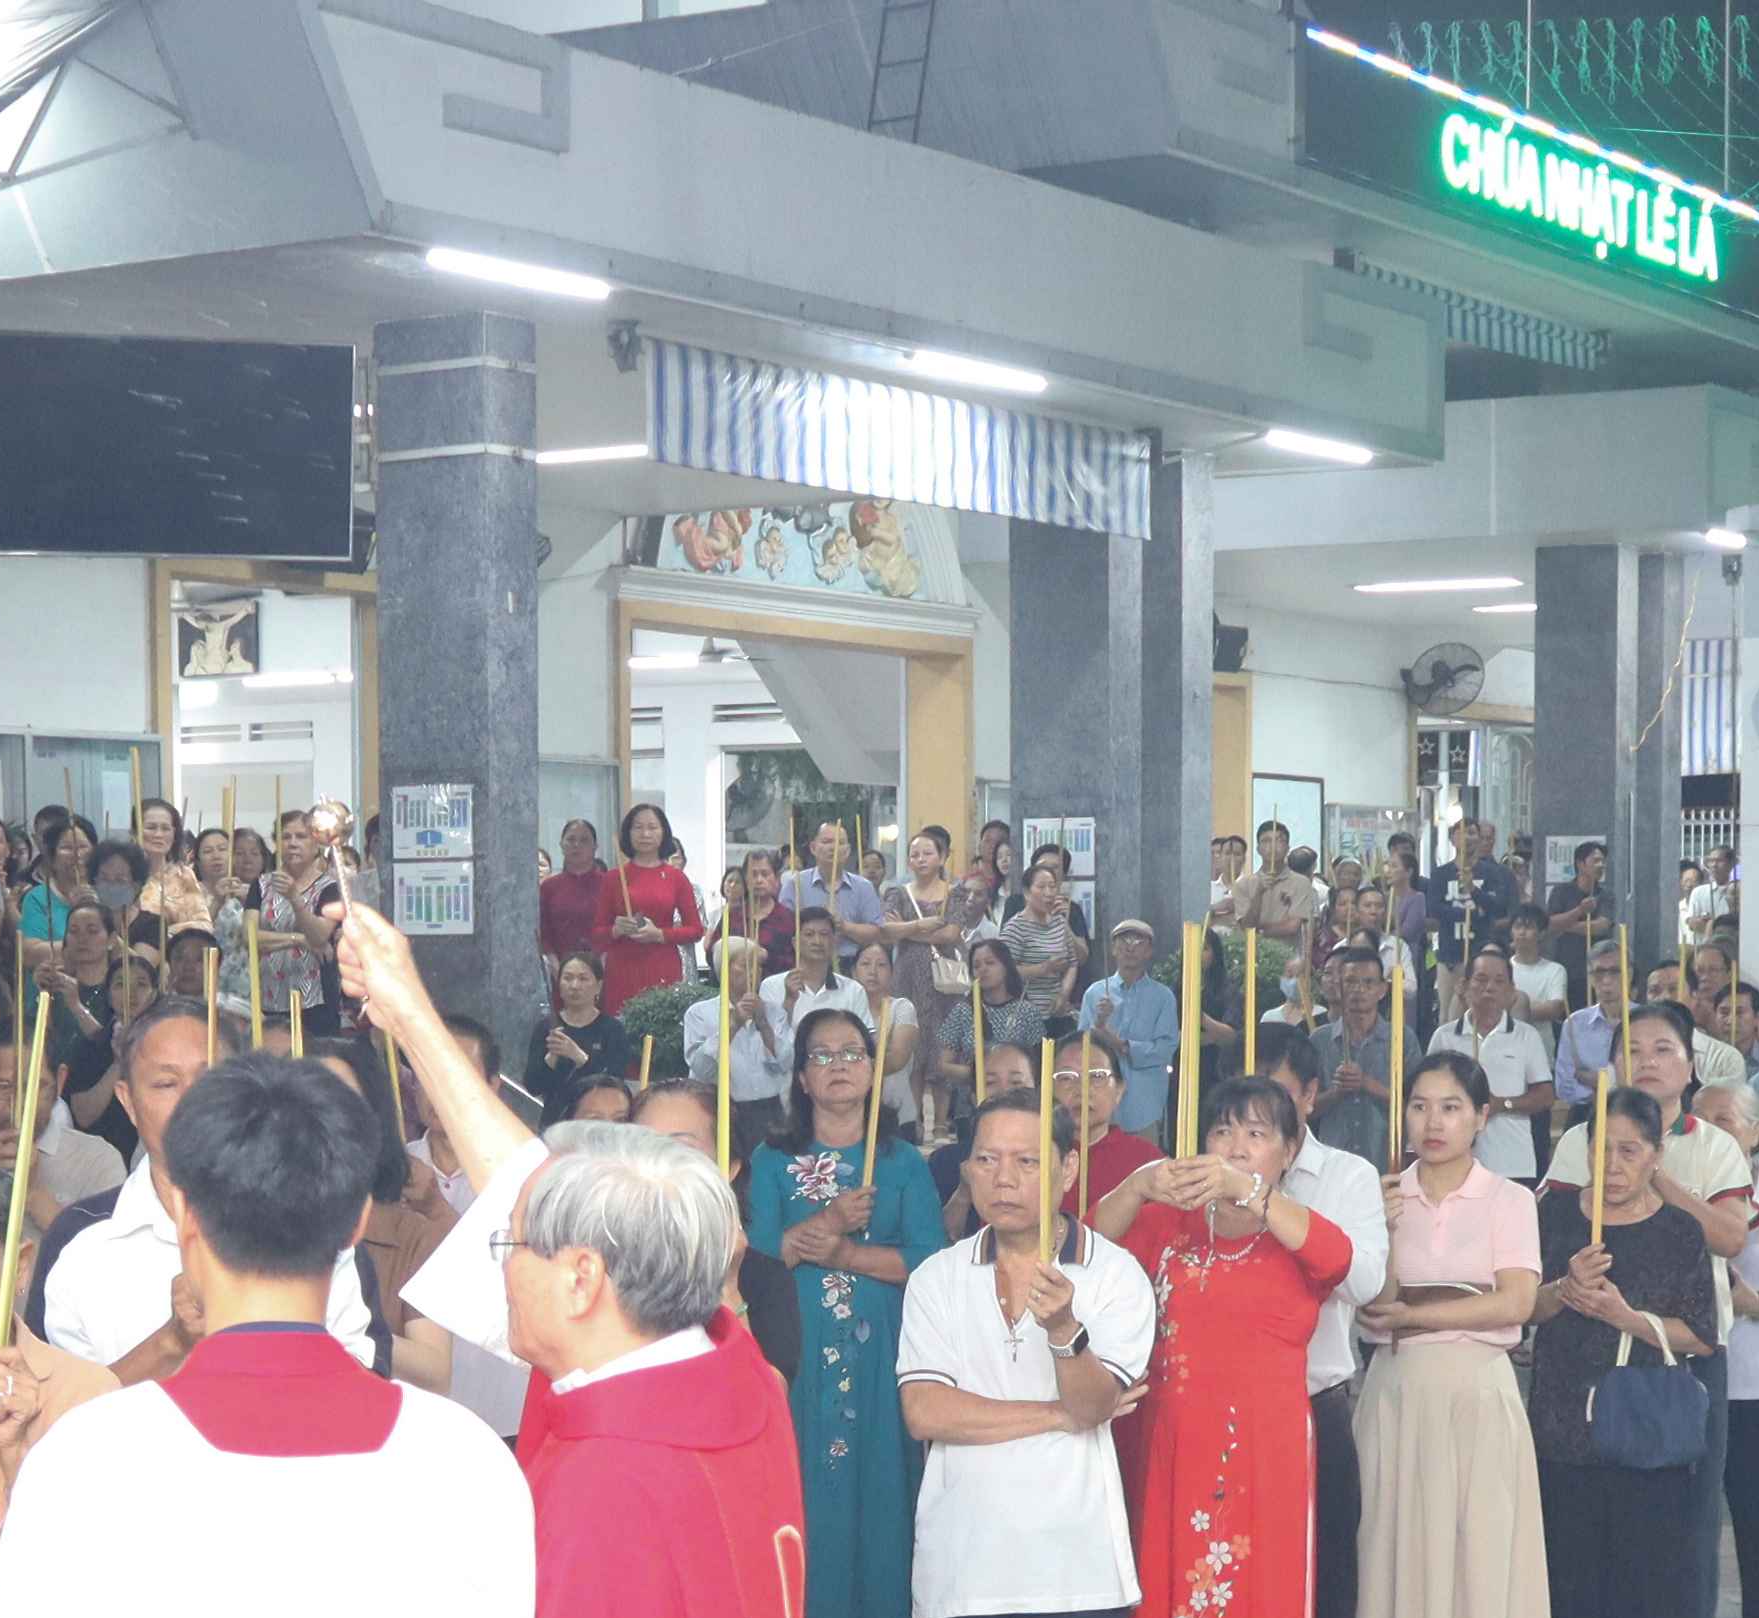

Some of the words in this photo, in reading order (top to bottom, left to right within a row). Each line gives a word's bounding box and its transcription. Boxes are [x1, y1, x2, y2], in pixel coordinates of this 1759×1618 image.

[1441, 113, 1543, 217] CHÚA
[1545, 153, 1634, 259] NHẬT
[1678, 199, 1718, 282] LÁ
